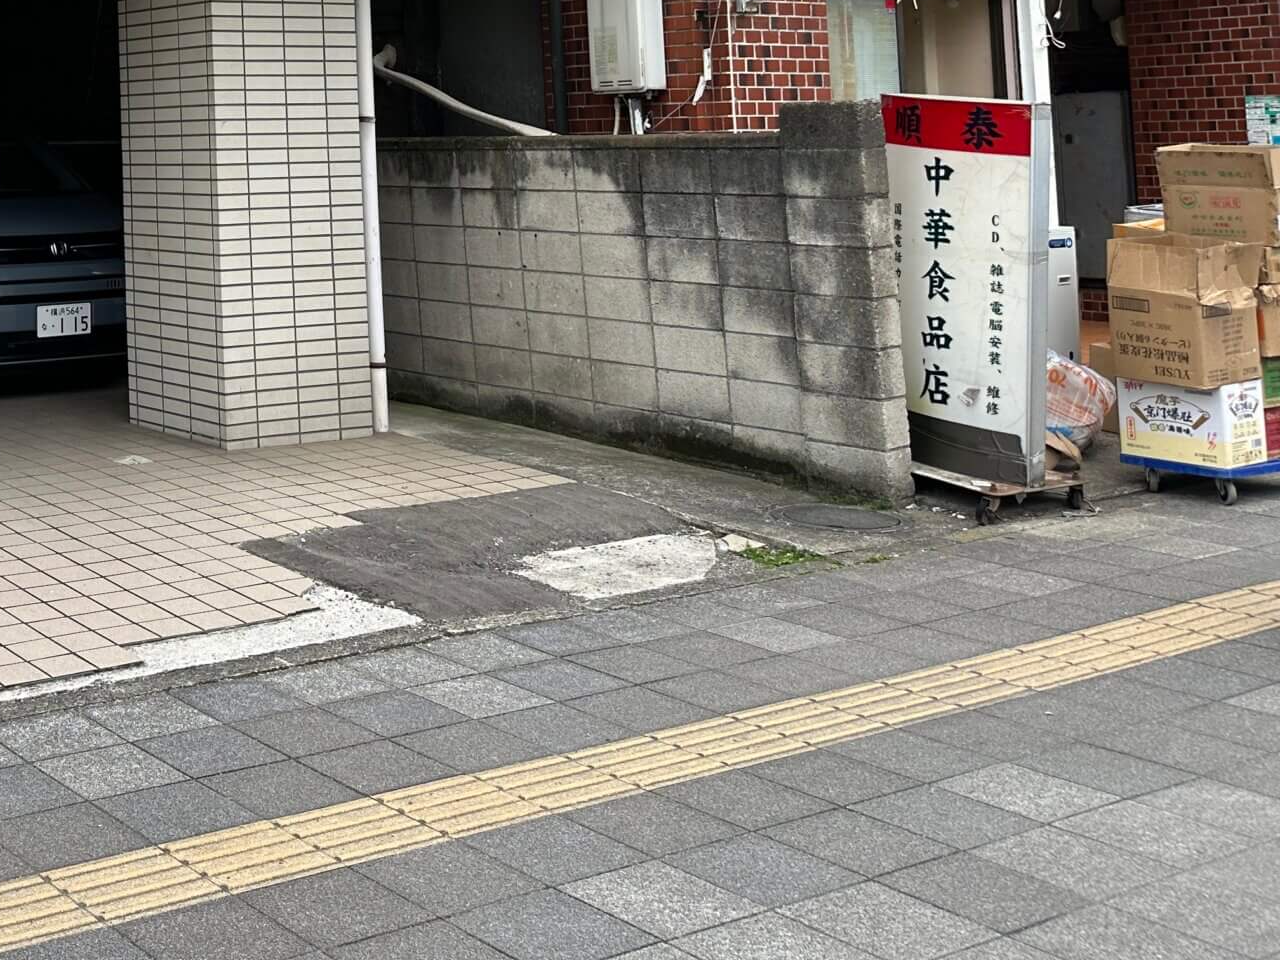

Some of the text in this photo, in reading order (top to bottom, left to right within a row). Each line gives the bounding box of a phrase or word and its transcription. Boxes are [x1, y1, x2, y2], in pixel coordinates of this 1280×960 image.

[920, 156, 956, 407] 中華食品店
